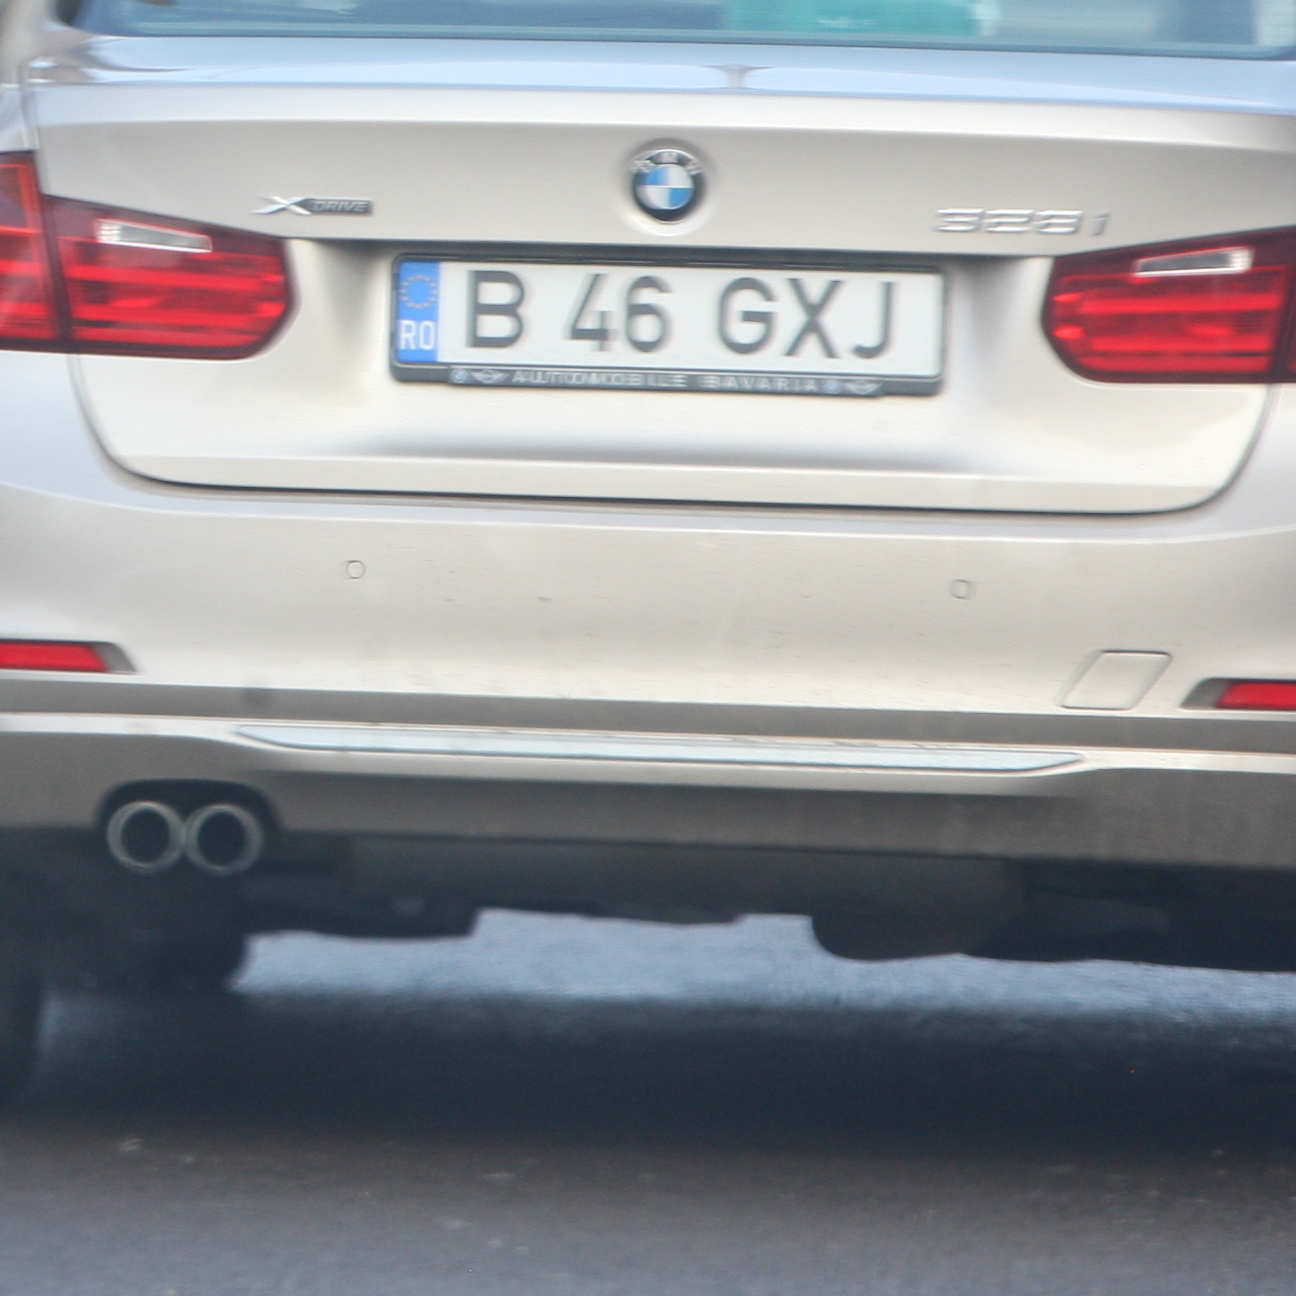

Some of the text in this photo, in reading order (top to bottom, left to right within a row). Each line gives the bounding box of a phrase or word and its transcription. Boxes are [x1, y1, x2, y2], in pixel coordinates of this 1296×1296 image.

[468, 270, 897, 359] B 46 GXJ
[400, 320, 435, 350] RO
[701, 375, 818, 394] BAVARIA
